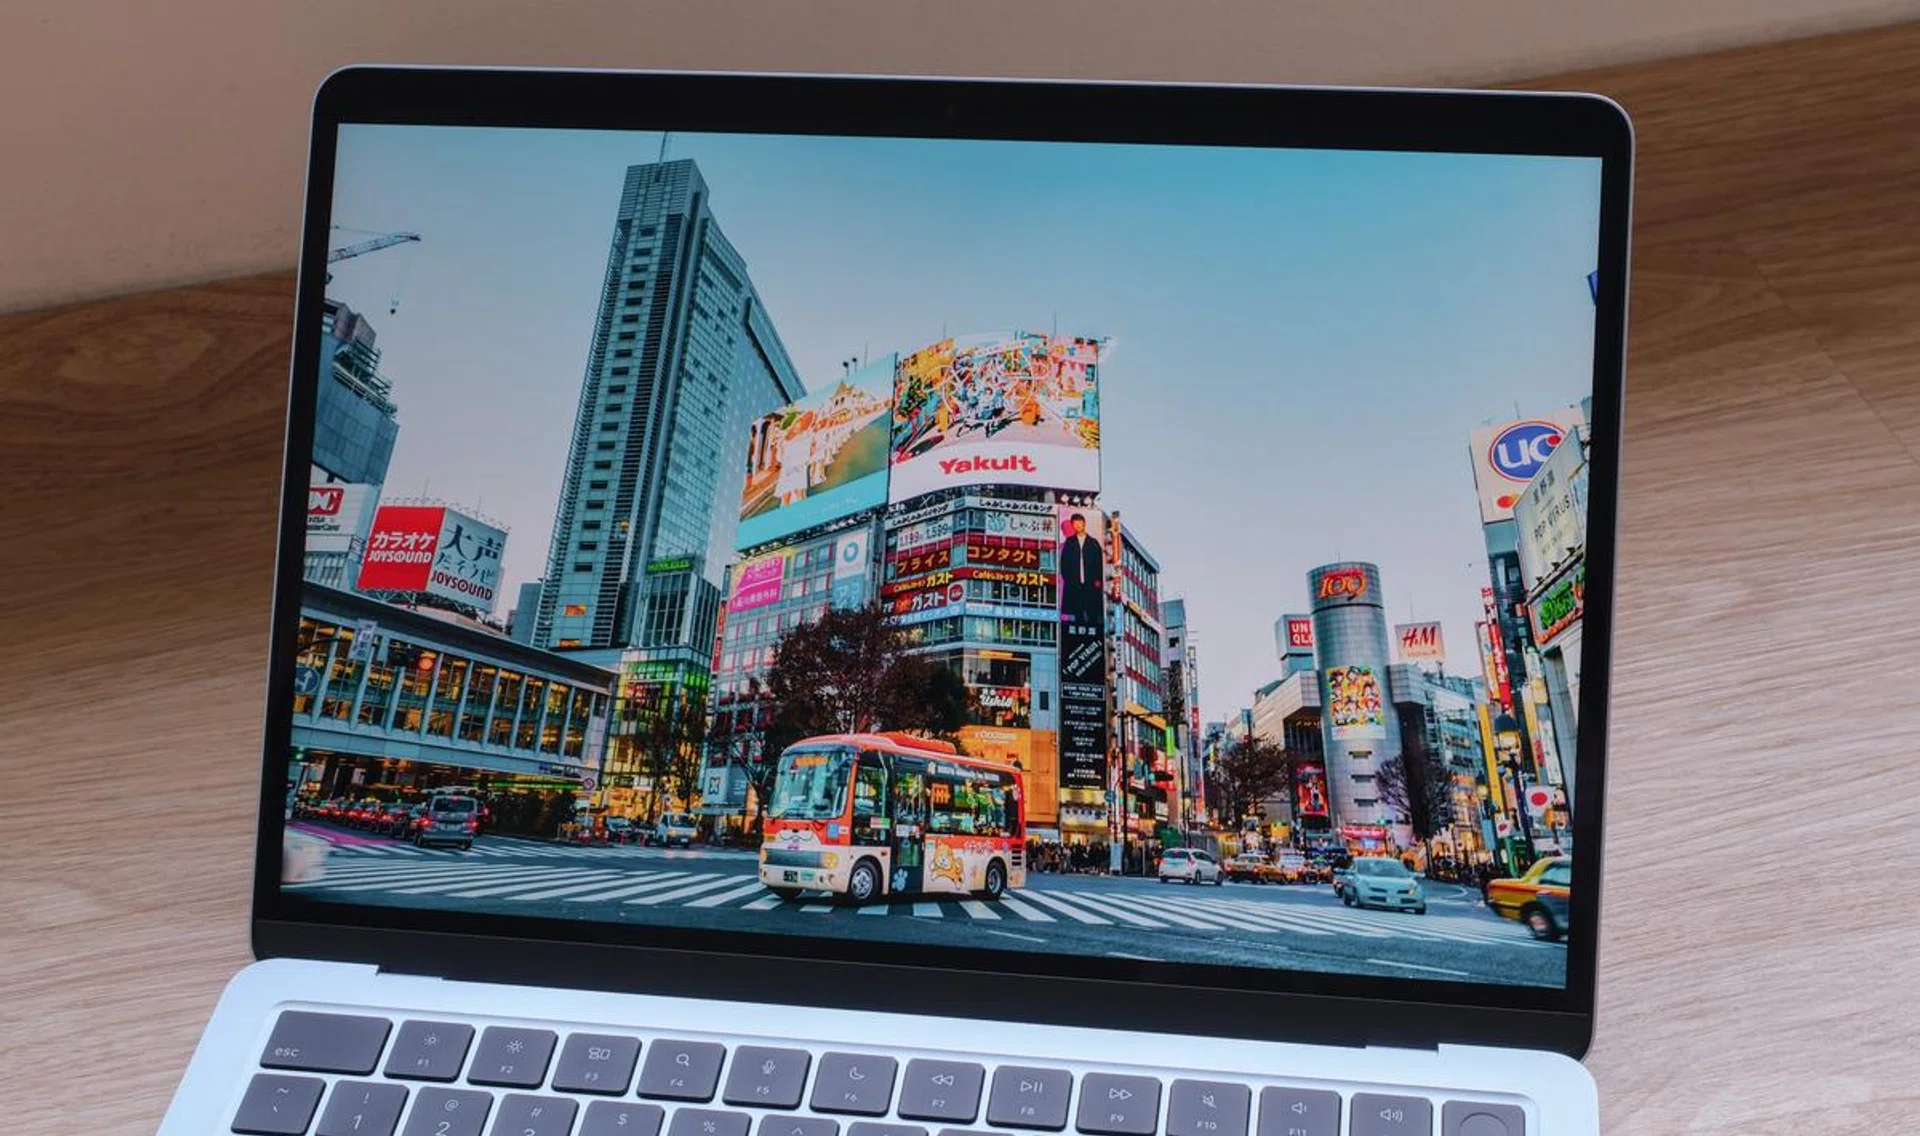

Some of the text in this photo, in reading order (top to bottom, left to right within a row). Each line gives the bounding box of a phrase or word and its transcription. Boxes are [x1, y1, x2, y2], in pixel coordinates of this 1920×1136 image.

[1498, 433, 1560, 468] UC
[939, 455, 1036, 474] Yakult
[372, 531, 435, 549] カラオケ
[368, 550, 432, 563] JOYSOUND
[967, 545, 1038, 564] コンタクト
[1016, 571, 1049, 586] ガスト
[431, 570, 493, 601] JOYSOUND
[911, 591, 945, 612] ガスト
[1291, 622, 1308, 633] UN
[1402, 626, 1436, 648] H&M
[274, 1047, 300, 1058] esc
[417, 1058, 430, 1067] F1
[500, 1065, 514, 1074] F2
[585, 1072, 598, 1081] F3
[670, 1078, 684, 1087] F4
[756, 1086, 770, 1095] F5
[844, 1092, 858, 1101] F6
[444, 1099, 459, 1111] @
[932, 1099, 946, 1108] F7
[530, 1108, 542, 1118] #
[1020, 1106, 1035, 1116] F8
[352, 1114, 363, 1130] 1
[616, 1113, 628, 1126] $
[1110, 1113, 1125, 1123] F9
[435, 1121, 451, 1136] 2
[703, 1120, 716, 1133] %
[1196, 1121, 1217, 1131] F10
[1289, 1128, 1307, 1136] F11
